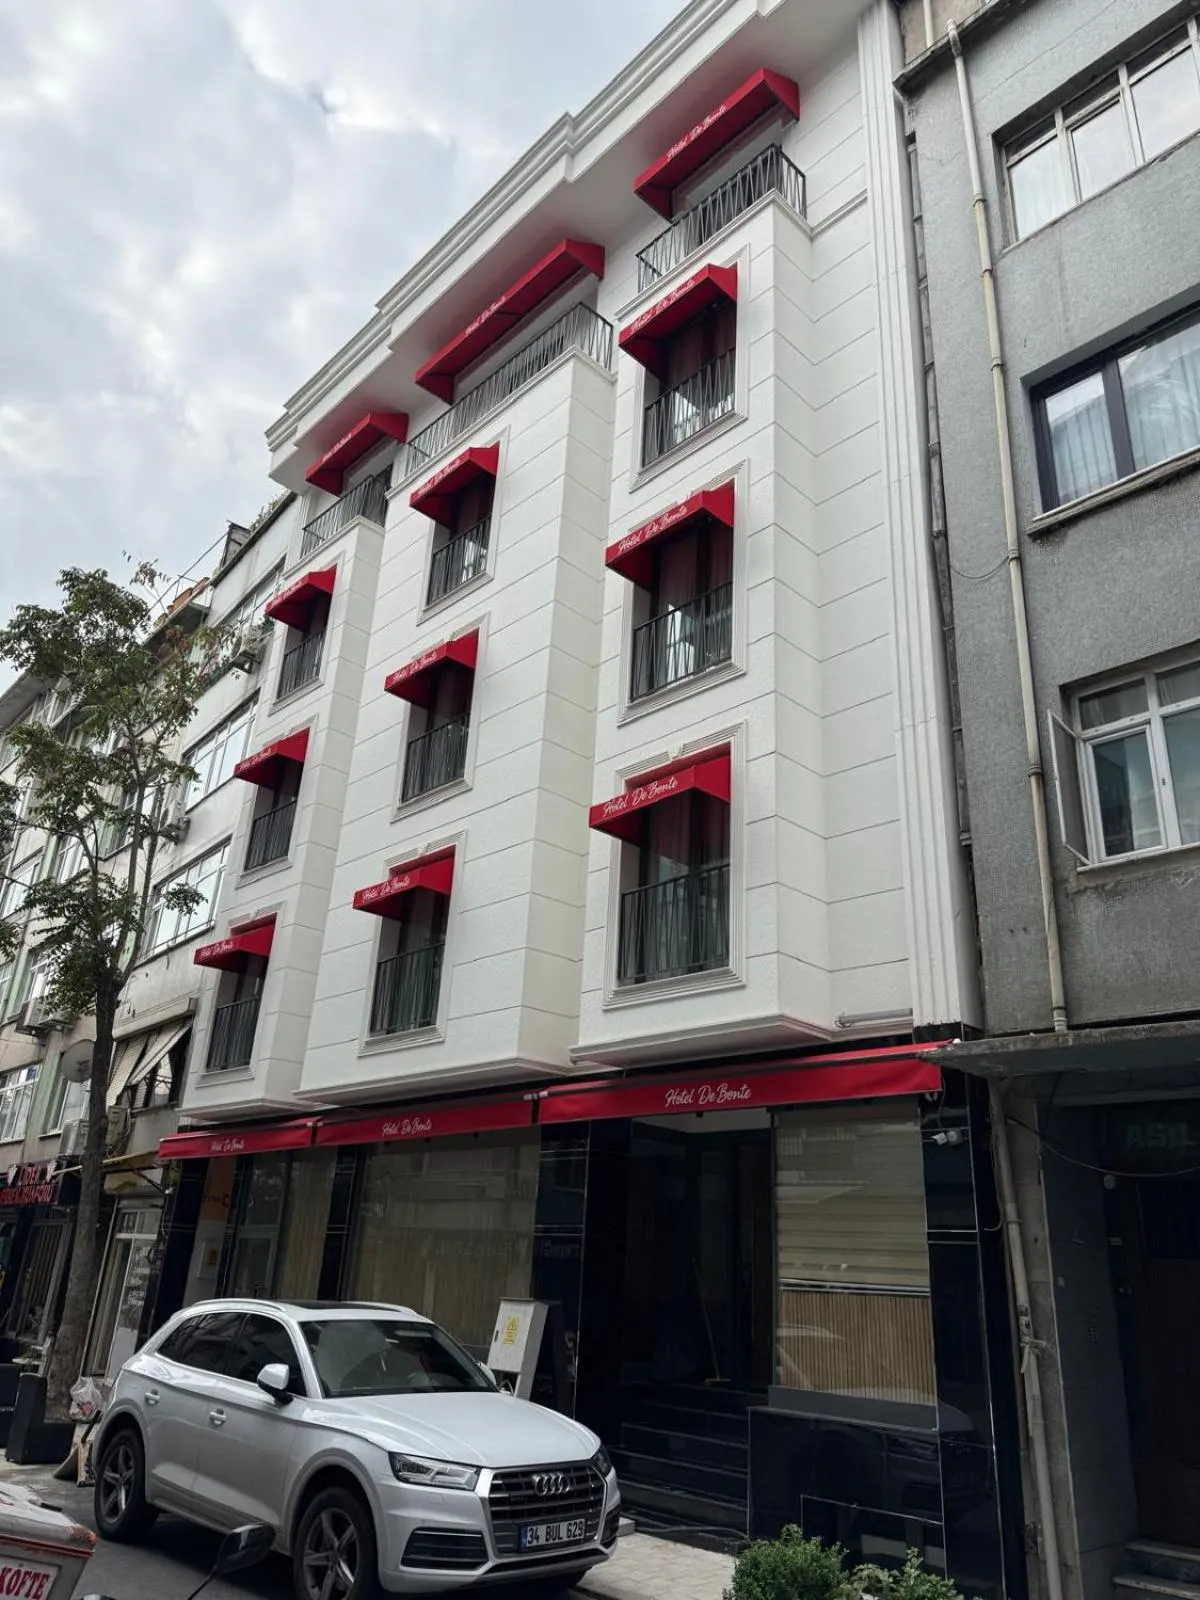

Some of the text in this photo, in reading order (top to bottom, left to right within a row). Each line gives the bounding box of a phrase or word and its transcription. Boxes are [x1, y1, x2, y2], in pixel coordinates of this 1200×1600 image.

[602, 776, 678, 818] Hotel De Bonte
[665, 1083, 752, 1108] Hotel De Bonte
[527, 1520, 584, 1544] 34 BUL 629
